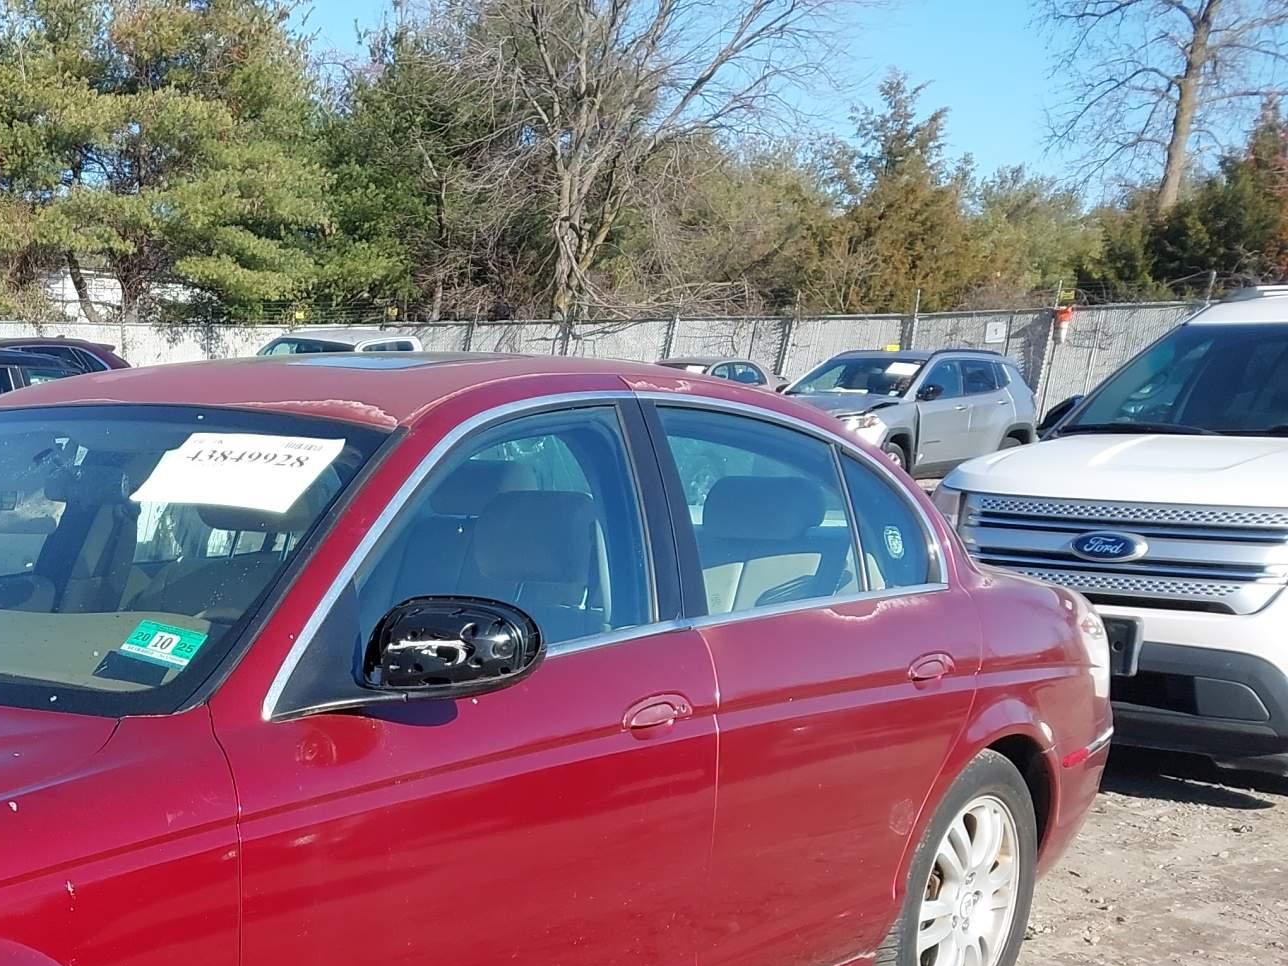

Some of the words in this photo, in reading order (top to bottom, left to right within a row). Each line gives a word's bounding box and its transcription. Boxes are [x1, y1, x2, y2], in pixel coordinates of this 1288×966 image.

[1083, 536, 1124, 553] Ford
[134, 631, 151, 642] 20
[152, 635, 173, 650] 10
[175, 643, 193, 653] 25
